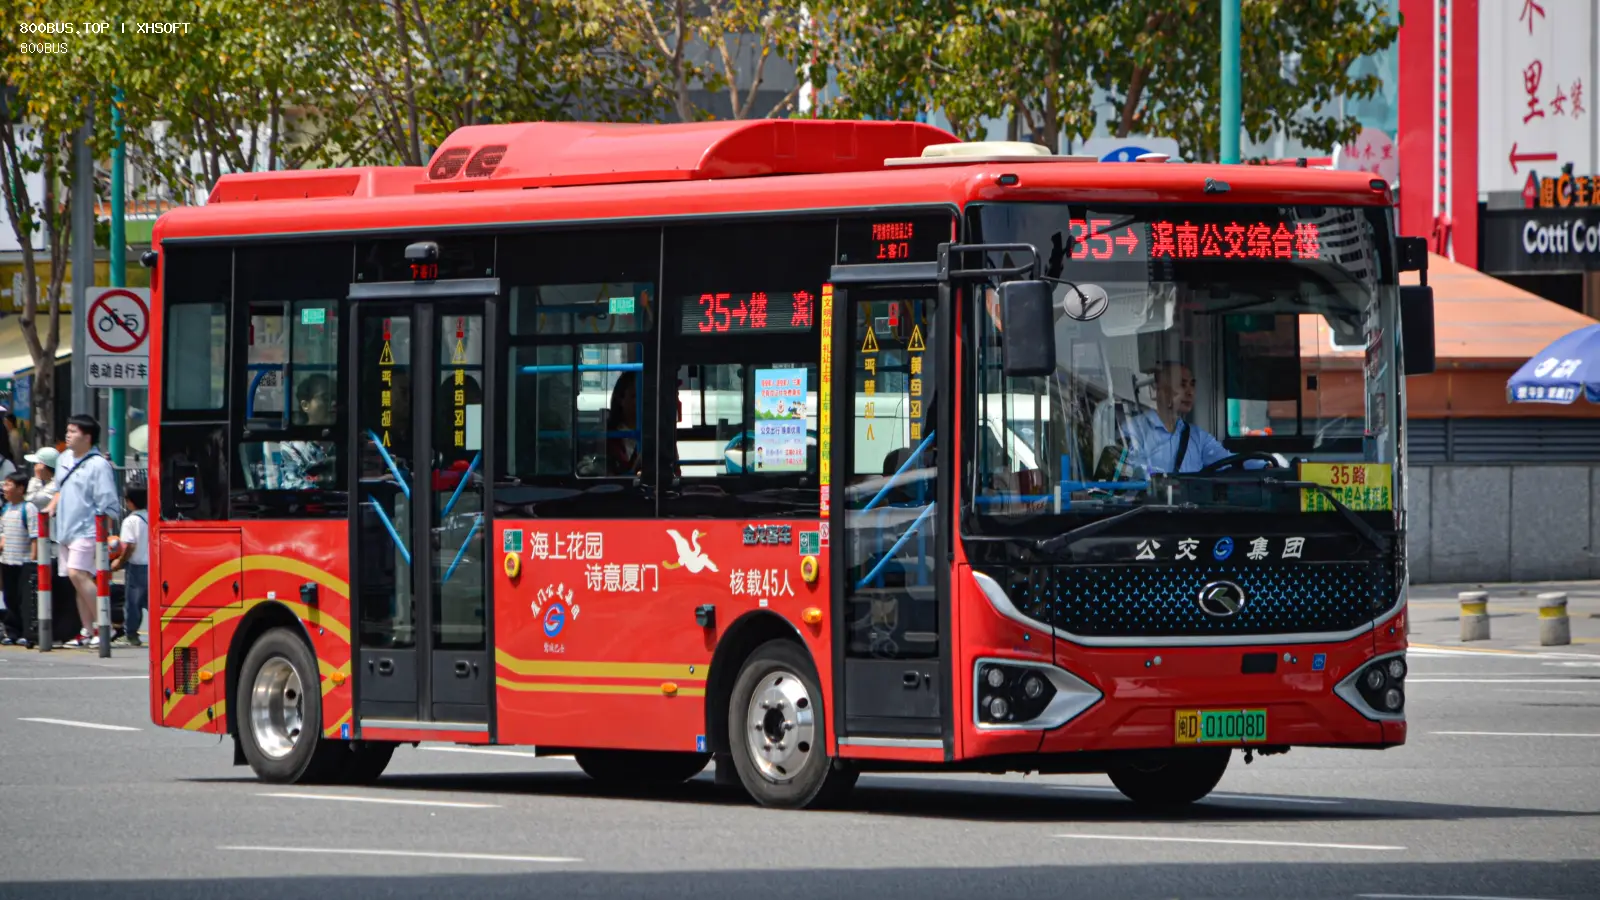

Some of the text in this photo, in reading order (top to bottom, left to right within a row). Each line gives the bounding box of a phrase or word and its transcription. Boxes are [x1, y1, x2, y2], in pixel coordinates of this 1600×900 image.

[1069, 219, 1319, 260] 35 滨南公交综合楼
[1522, 218, 1600, 254] Cotti Co
[876, 242, 909, 260] 上客门
[698, 293, 731, 332] 35
[89, 362, 148, 379] 电动自行车
[1330, 465, 1366, 485] 35路
[529, 531, 603, 560] 海上花园
[743, 524, 792, 546] 金龙客车
[1135, 536, 1306, 561] 公交 集团
[584, 562, 659, 592] 诗意厦门
[729, 568, 795, 597] 核载45人
[1205, 714, 1265, 738] 01008D
